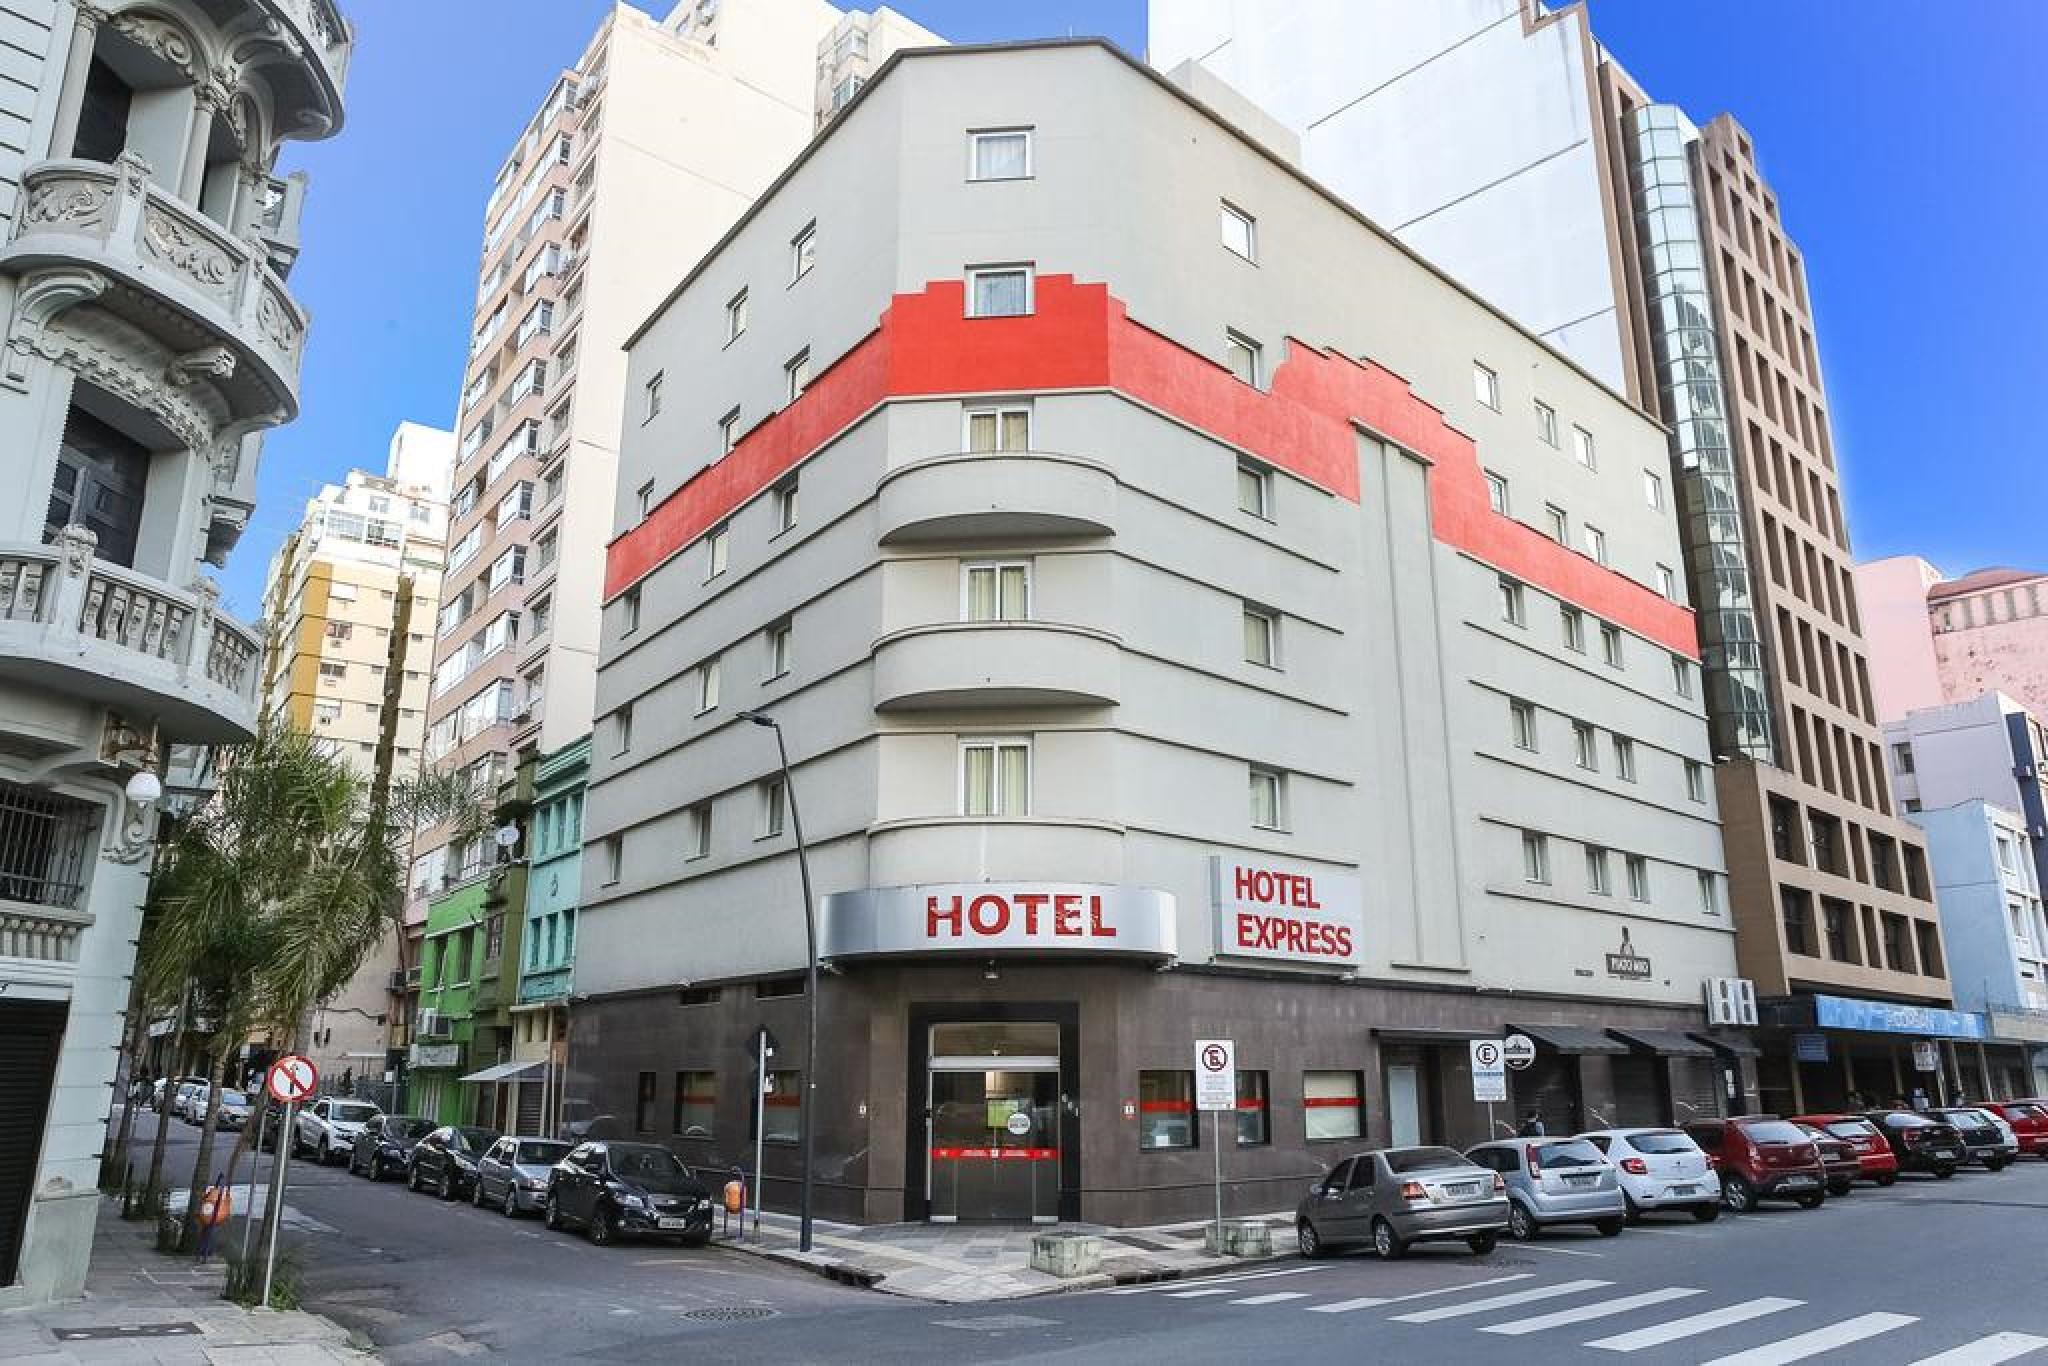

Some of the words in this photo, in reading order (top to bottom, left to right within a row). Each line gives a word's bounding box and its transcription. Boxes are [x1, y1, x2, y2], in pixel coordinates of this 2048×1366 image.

[1234, 866, 1321, 910] HOTEL
[927, 894, 1117, 937] HOTEL
[1237, 913, 1353, 957] EXPRESS
[1484, 1048, 1491, 1060] E
